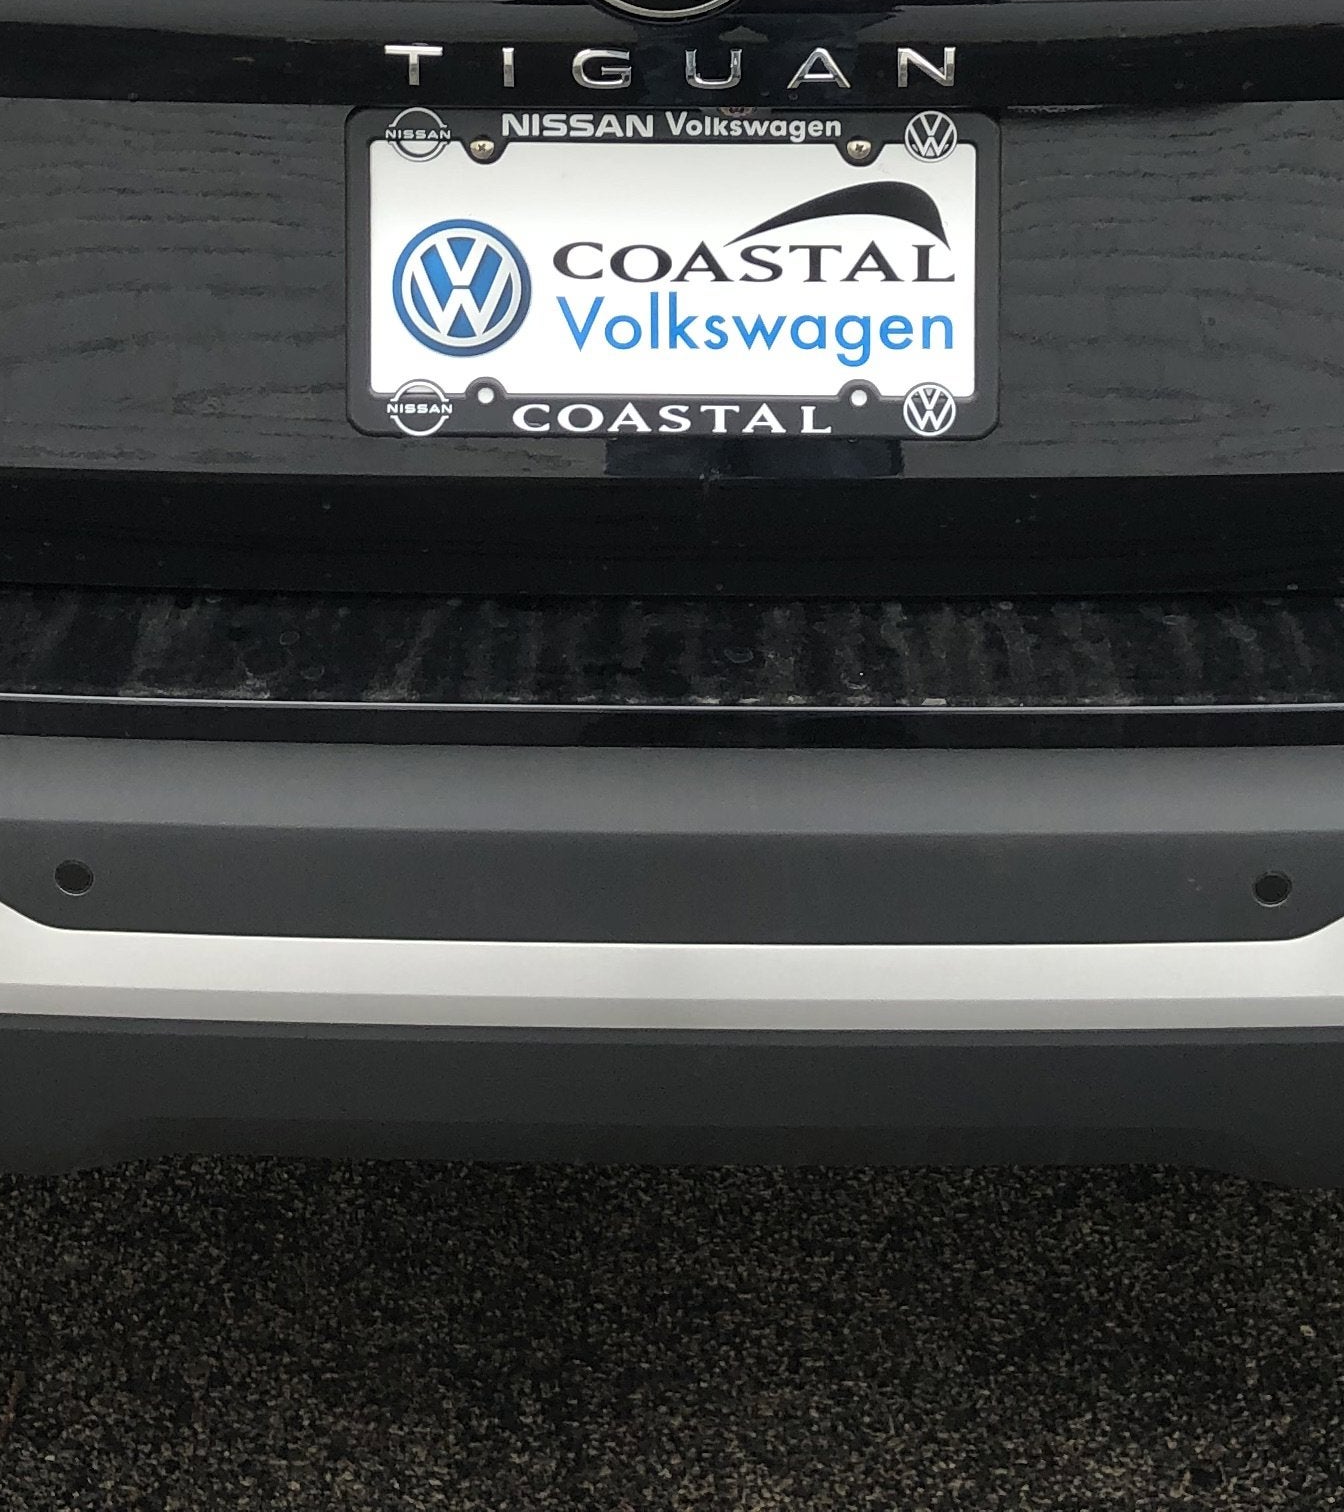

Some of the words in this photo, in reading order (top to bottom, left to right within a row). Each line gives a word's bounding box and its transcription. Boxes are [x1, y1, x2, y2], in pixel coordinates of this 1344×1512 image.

[383, 44, 957, 89] TIGUAN
[385, 128, 451, 140] NISSAN
[501, 112, 655, 138] NISSAN
[665, 110, 842, 143] Volkswagen
[552, 240, 956, 283] COASTAL
[556, 291, 954, 367] Volkswagen
[386, 402, 453, 414] NISSAN
[512, 402, 832, 434] COASTAL
